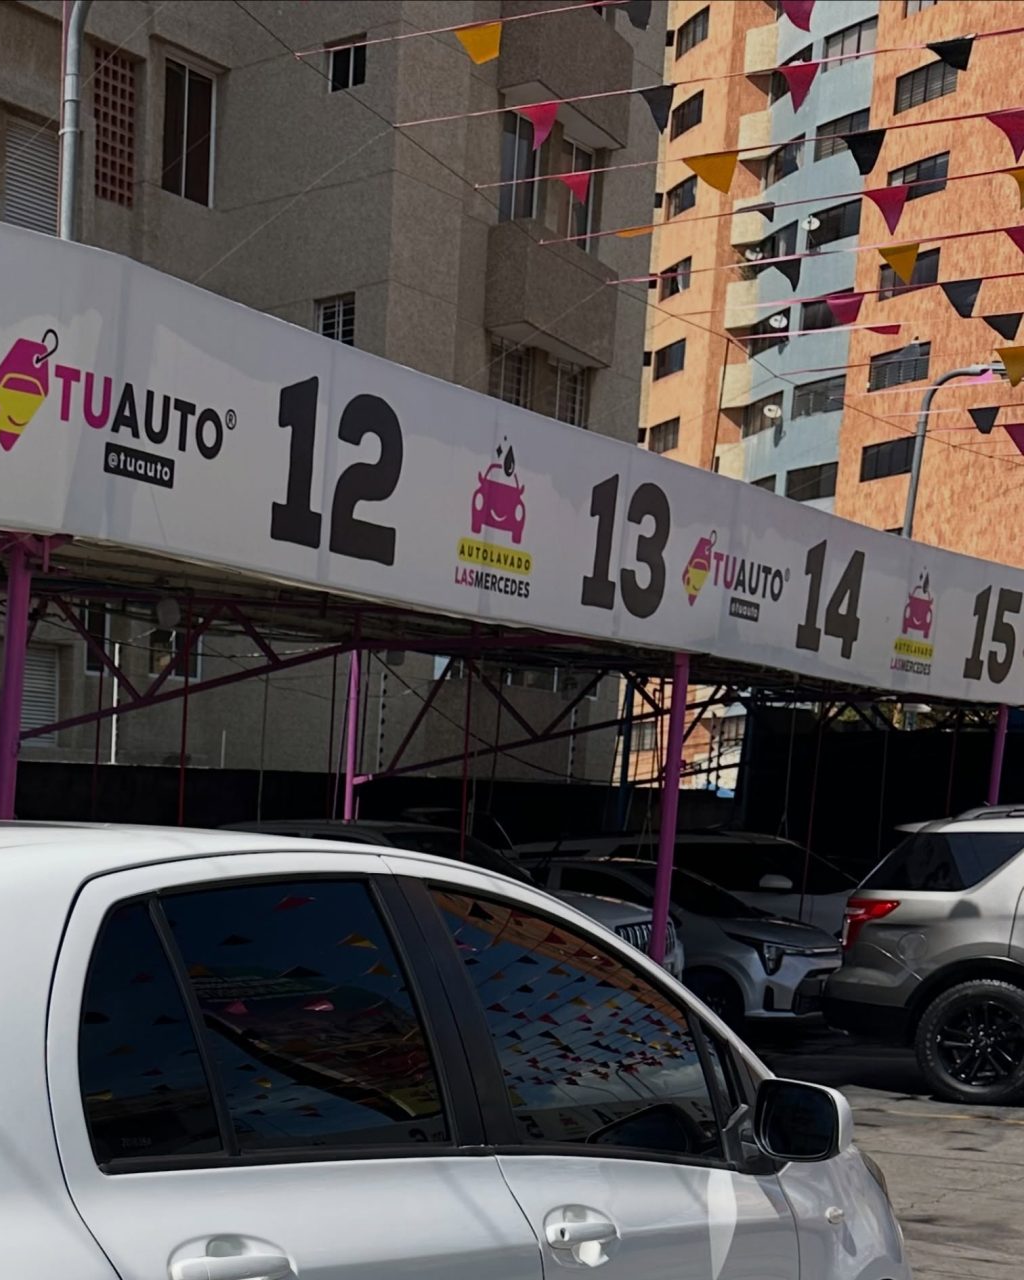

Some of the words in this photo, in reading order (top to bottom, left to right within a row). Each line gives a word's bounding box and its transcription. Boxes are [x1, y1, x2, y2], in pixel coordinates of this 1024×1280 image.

[107, 451, 171, 482] @tuauto
[269, 376, 404, 566] 12
[459, 543, 531, 571] AUTOLAVADO
[581, 473, 671, 619] 13
[795, 538, 866, 660] 14
[963, 585, 1023, 684] 15
